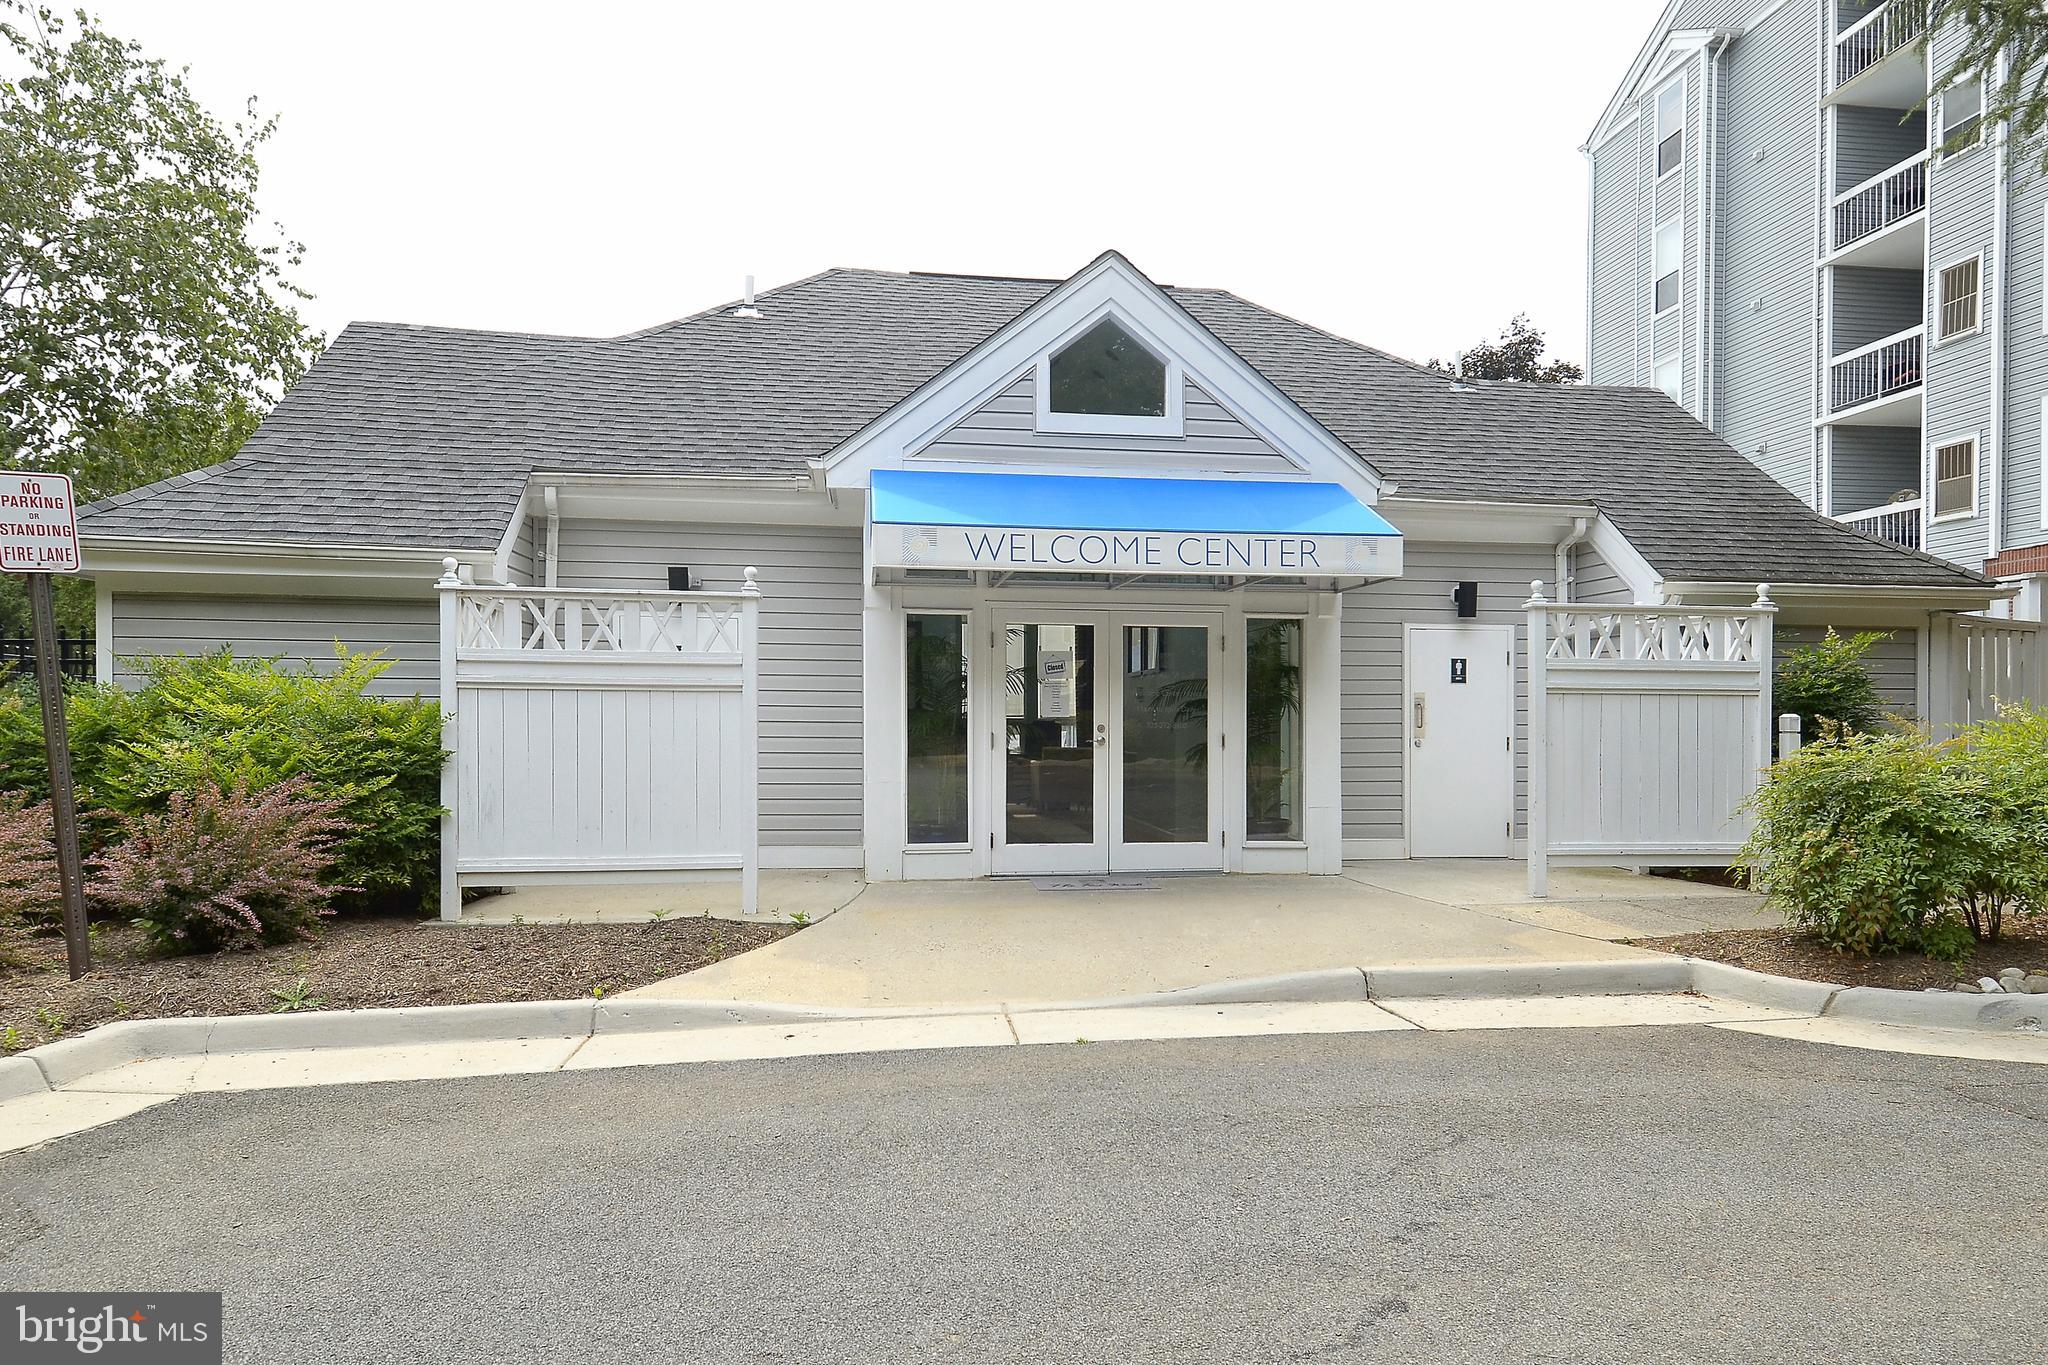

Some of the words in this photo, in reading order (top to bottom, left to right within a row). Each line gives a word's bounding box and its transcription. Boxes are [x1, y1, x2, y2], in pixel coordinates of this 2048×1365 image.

[21, 482, 41, 495] NO
[1, 495, 64, 509] PARKING
[28, 512, 40, 520] OR
[0, 523, 72, 537] STANDING
[4, 546, 34, 561] FIRE
[39, 547, 73, 562] LANE
[964, 532, 1162, 565] WELCOME
[1177, 538, 1320, 568] CENTER
